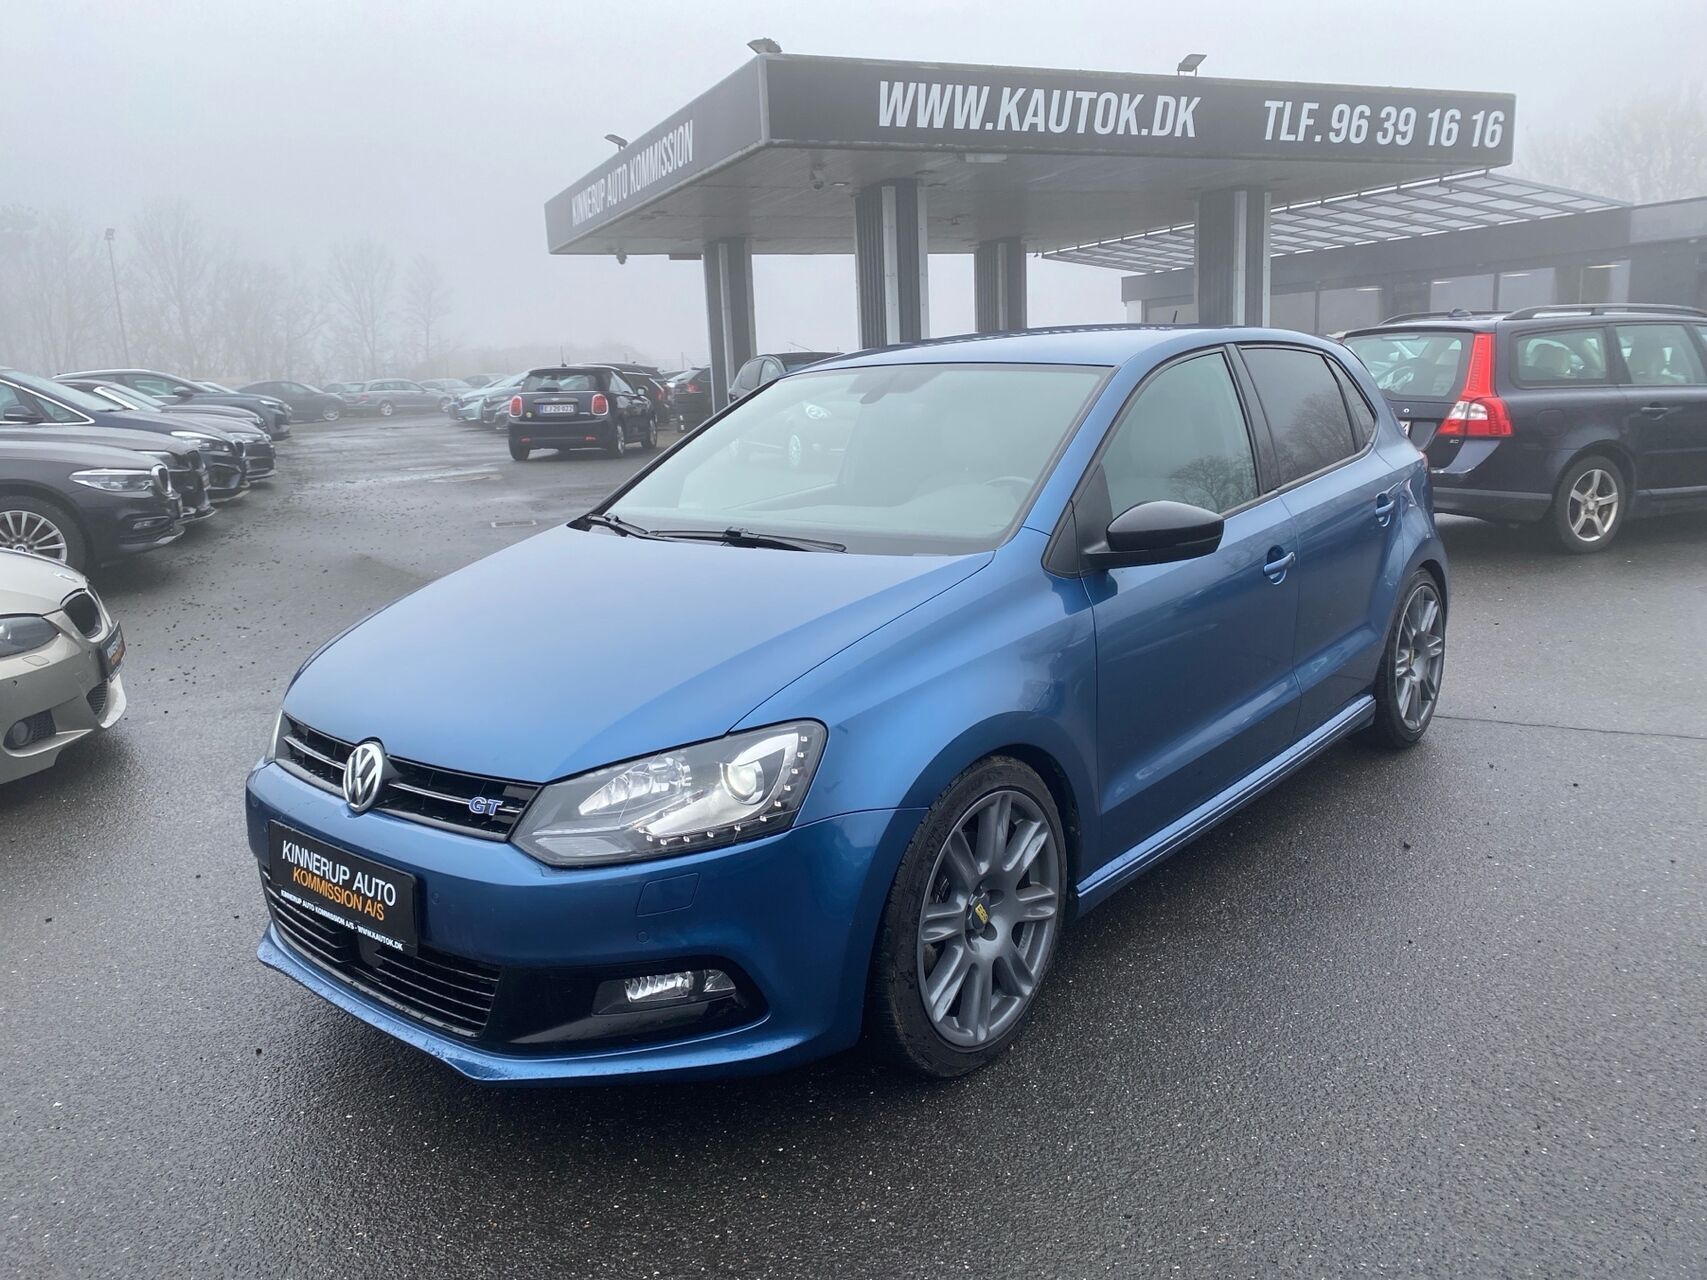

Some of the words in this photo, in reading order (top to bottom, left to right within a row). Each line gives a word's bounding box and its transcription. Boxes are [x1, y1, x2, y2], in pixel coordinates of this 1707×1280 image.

[879, 80, 1202, 138] WWW.KAUTOK.DK
[1264, 100, 1322, 142] TLF.
[1328, 103, 1371, 144] 96
[1376, 106, 1417, 146] 39
[1427, 108, 1461, 147] 16
[1471, 110, 1505, 148] 16
[571, 178, 606, 227] KINNERUP
[606, 163, 628, 208] AUTO
[629, 119, 693, 196] KOMMISSION
[468, 797, 503, 815] GT
[281, 840, 350, 886] KINNERUP
[353, 870, 396, 907] AUTO
[292, 866, 363, 912] KOMMISSION
[365, 900, 385, 921] A/S
